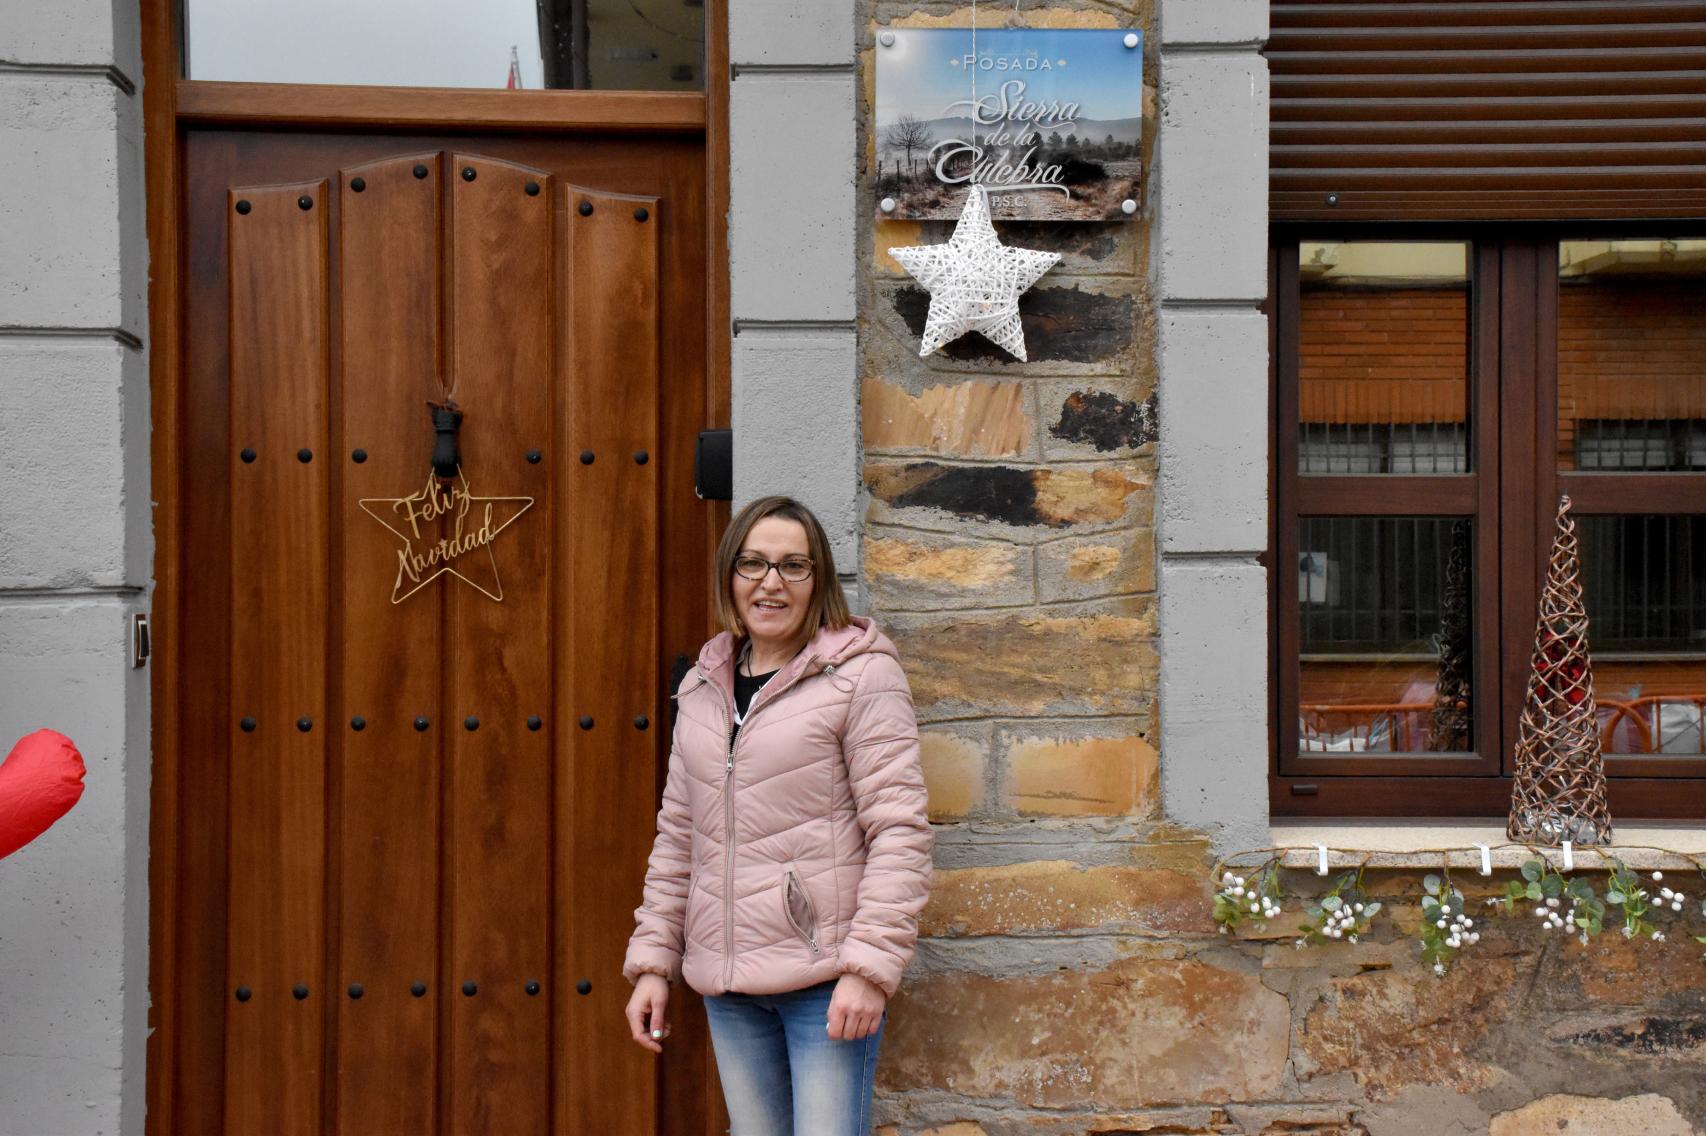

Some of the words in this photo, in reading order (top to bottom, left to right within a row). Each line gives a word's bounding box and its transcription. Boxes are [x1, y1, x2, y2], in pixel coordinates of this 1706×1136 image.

[963, 54, 1052, 71] POSADA
[943, 80, 1081, 129] Sierra
[984, 122, 1010, 146] de
[1012, 123, 1037, 146] la
[928, 139, 1066, 185] Culebra
[393, 475, 470, 539] Feliz
[396, 503, 496, 589] Navidad
